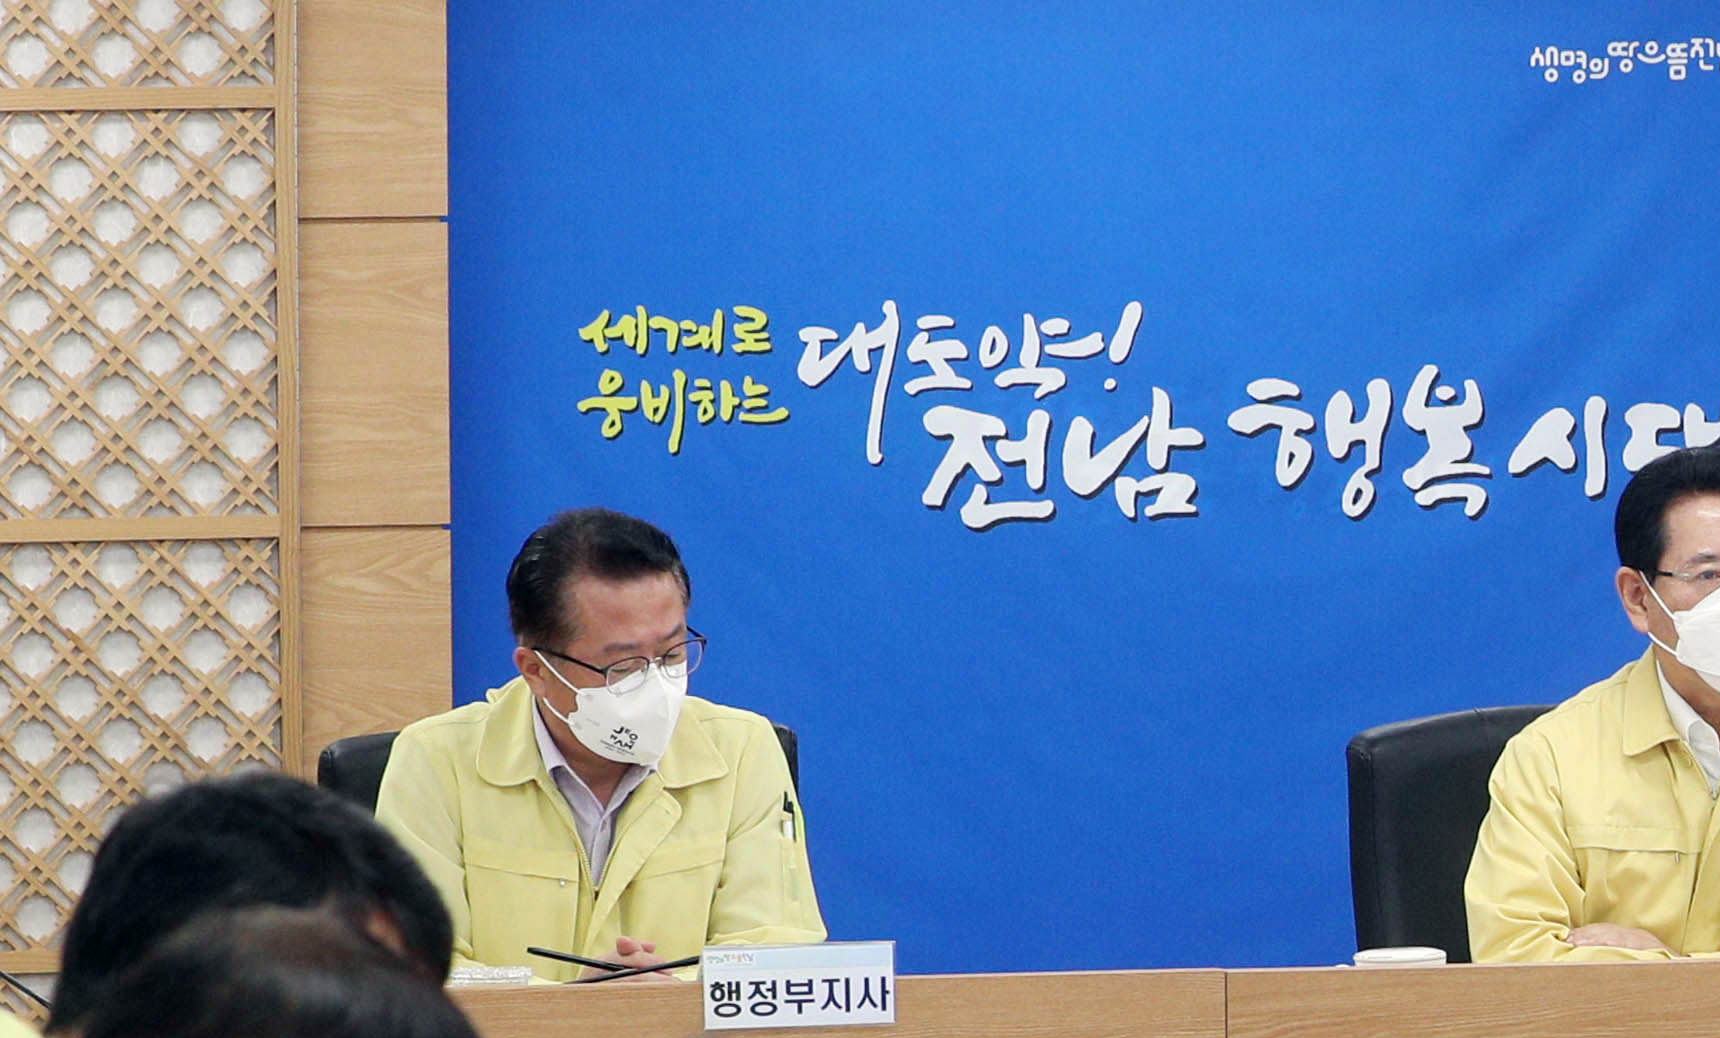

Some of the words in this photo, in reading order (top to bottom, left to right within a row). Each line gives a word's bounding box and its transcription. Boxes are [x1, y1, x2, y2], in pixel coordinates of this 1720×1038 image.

[578, 305, 772, 355] 세계로
[577, 369, 790, 453] 웅비하는
[797, 299, 1142, 464] 대도약!
[921, 386, 1205, 529] 전남
[1227, 364, 1491, 518] 행복
[709, 976, 891, 1018] 행정부지사
